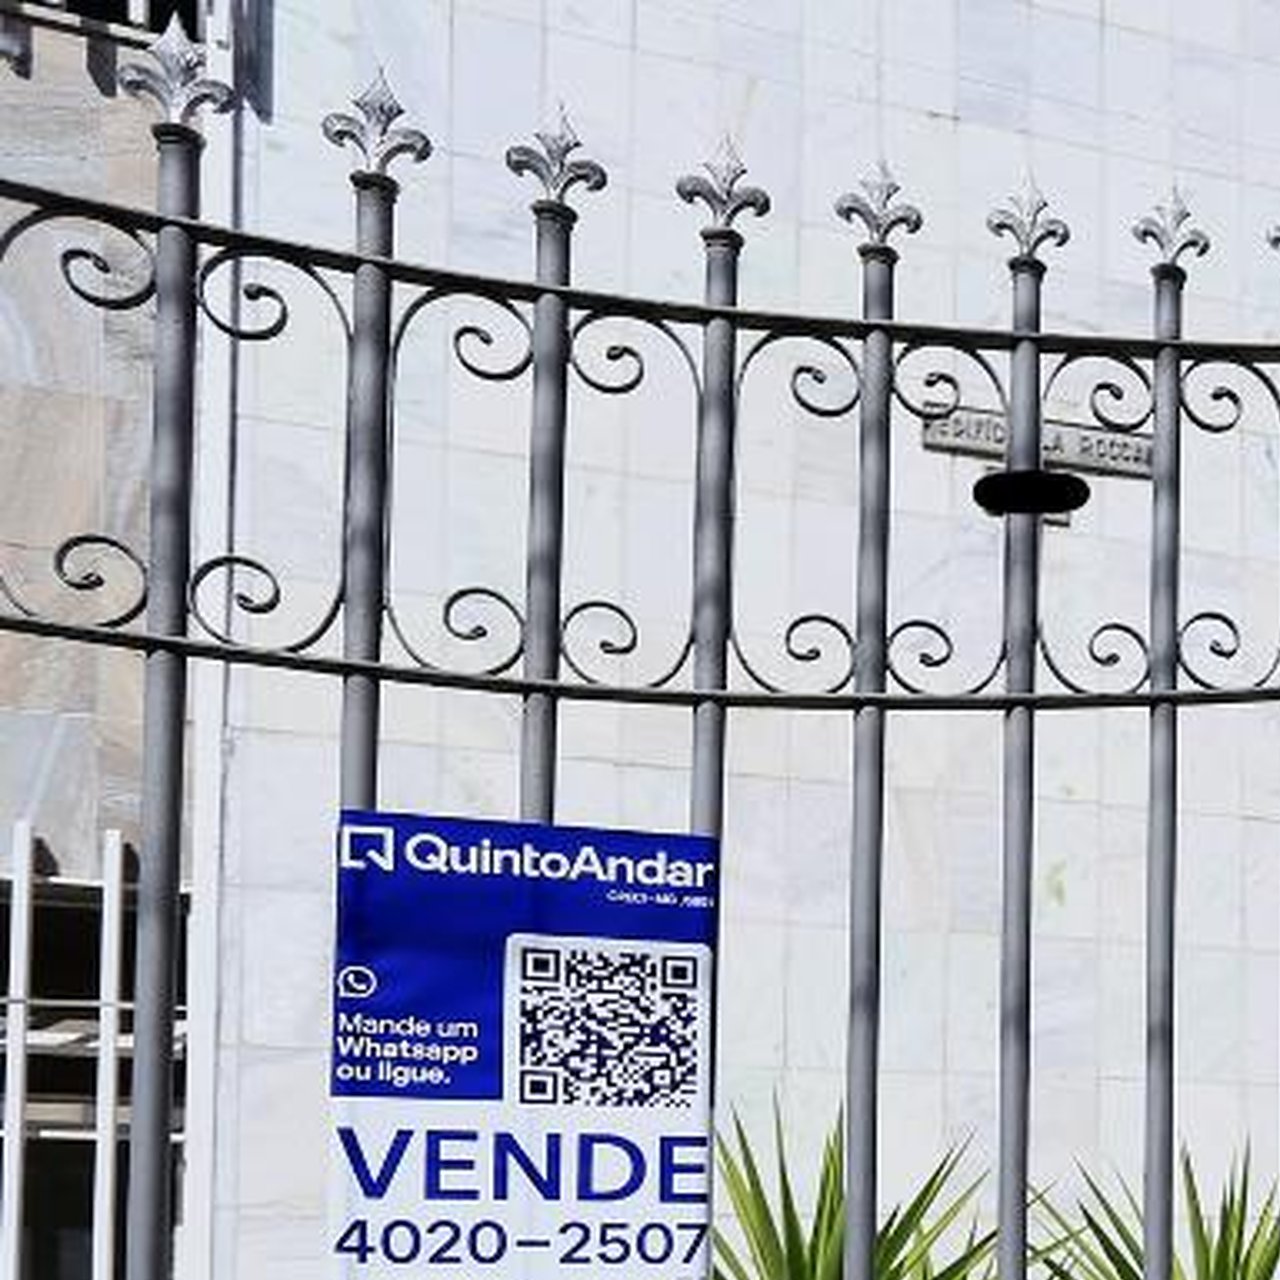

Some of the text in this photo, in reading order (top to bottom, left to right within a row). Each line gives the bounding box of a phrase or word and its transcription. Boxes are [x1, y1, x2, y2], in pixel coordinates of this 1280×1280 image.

[404, 834, 714, 887] QuintoAndar
[338, 1012, 479, 1038] Mande um
[337, 1036, 480, 1065] Whatsapp
[336, 1060, 452, 1088] ou ligue.
[337, 1127, 710, 1203] VENDE
[334, 1220, 712, 1265] 4020-2507
